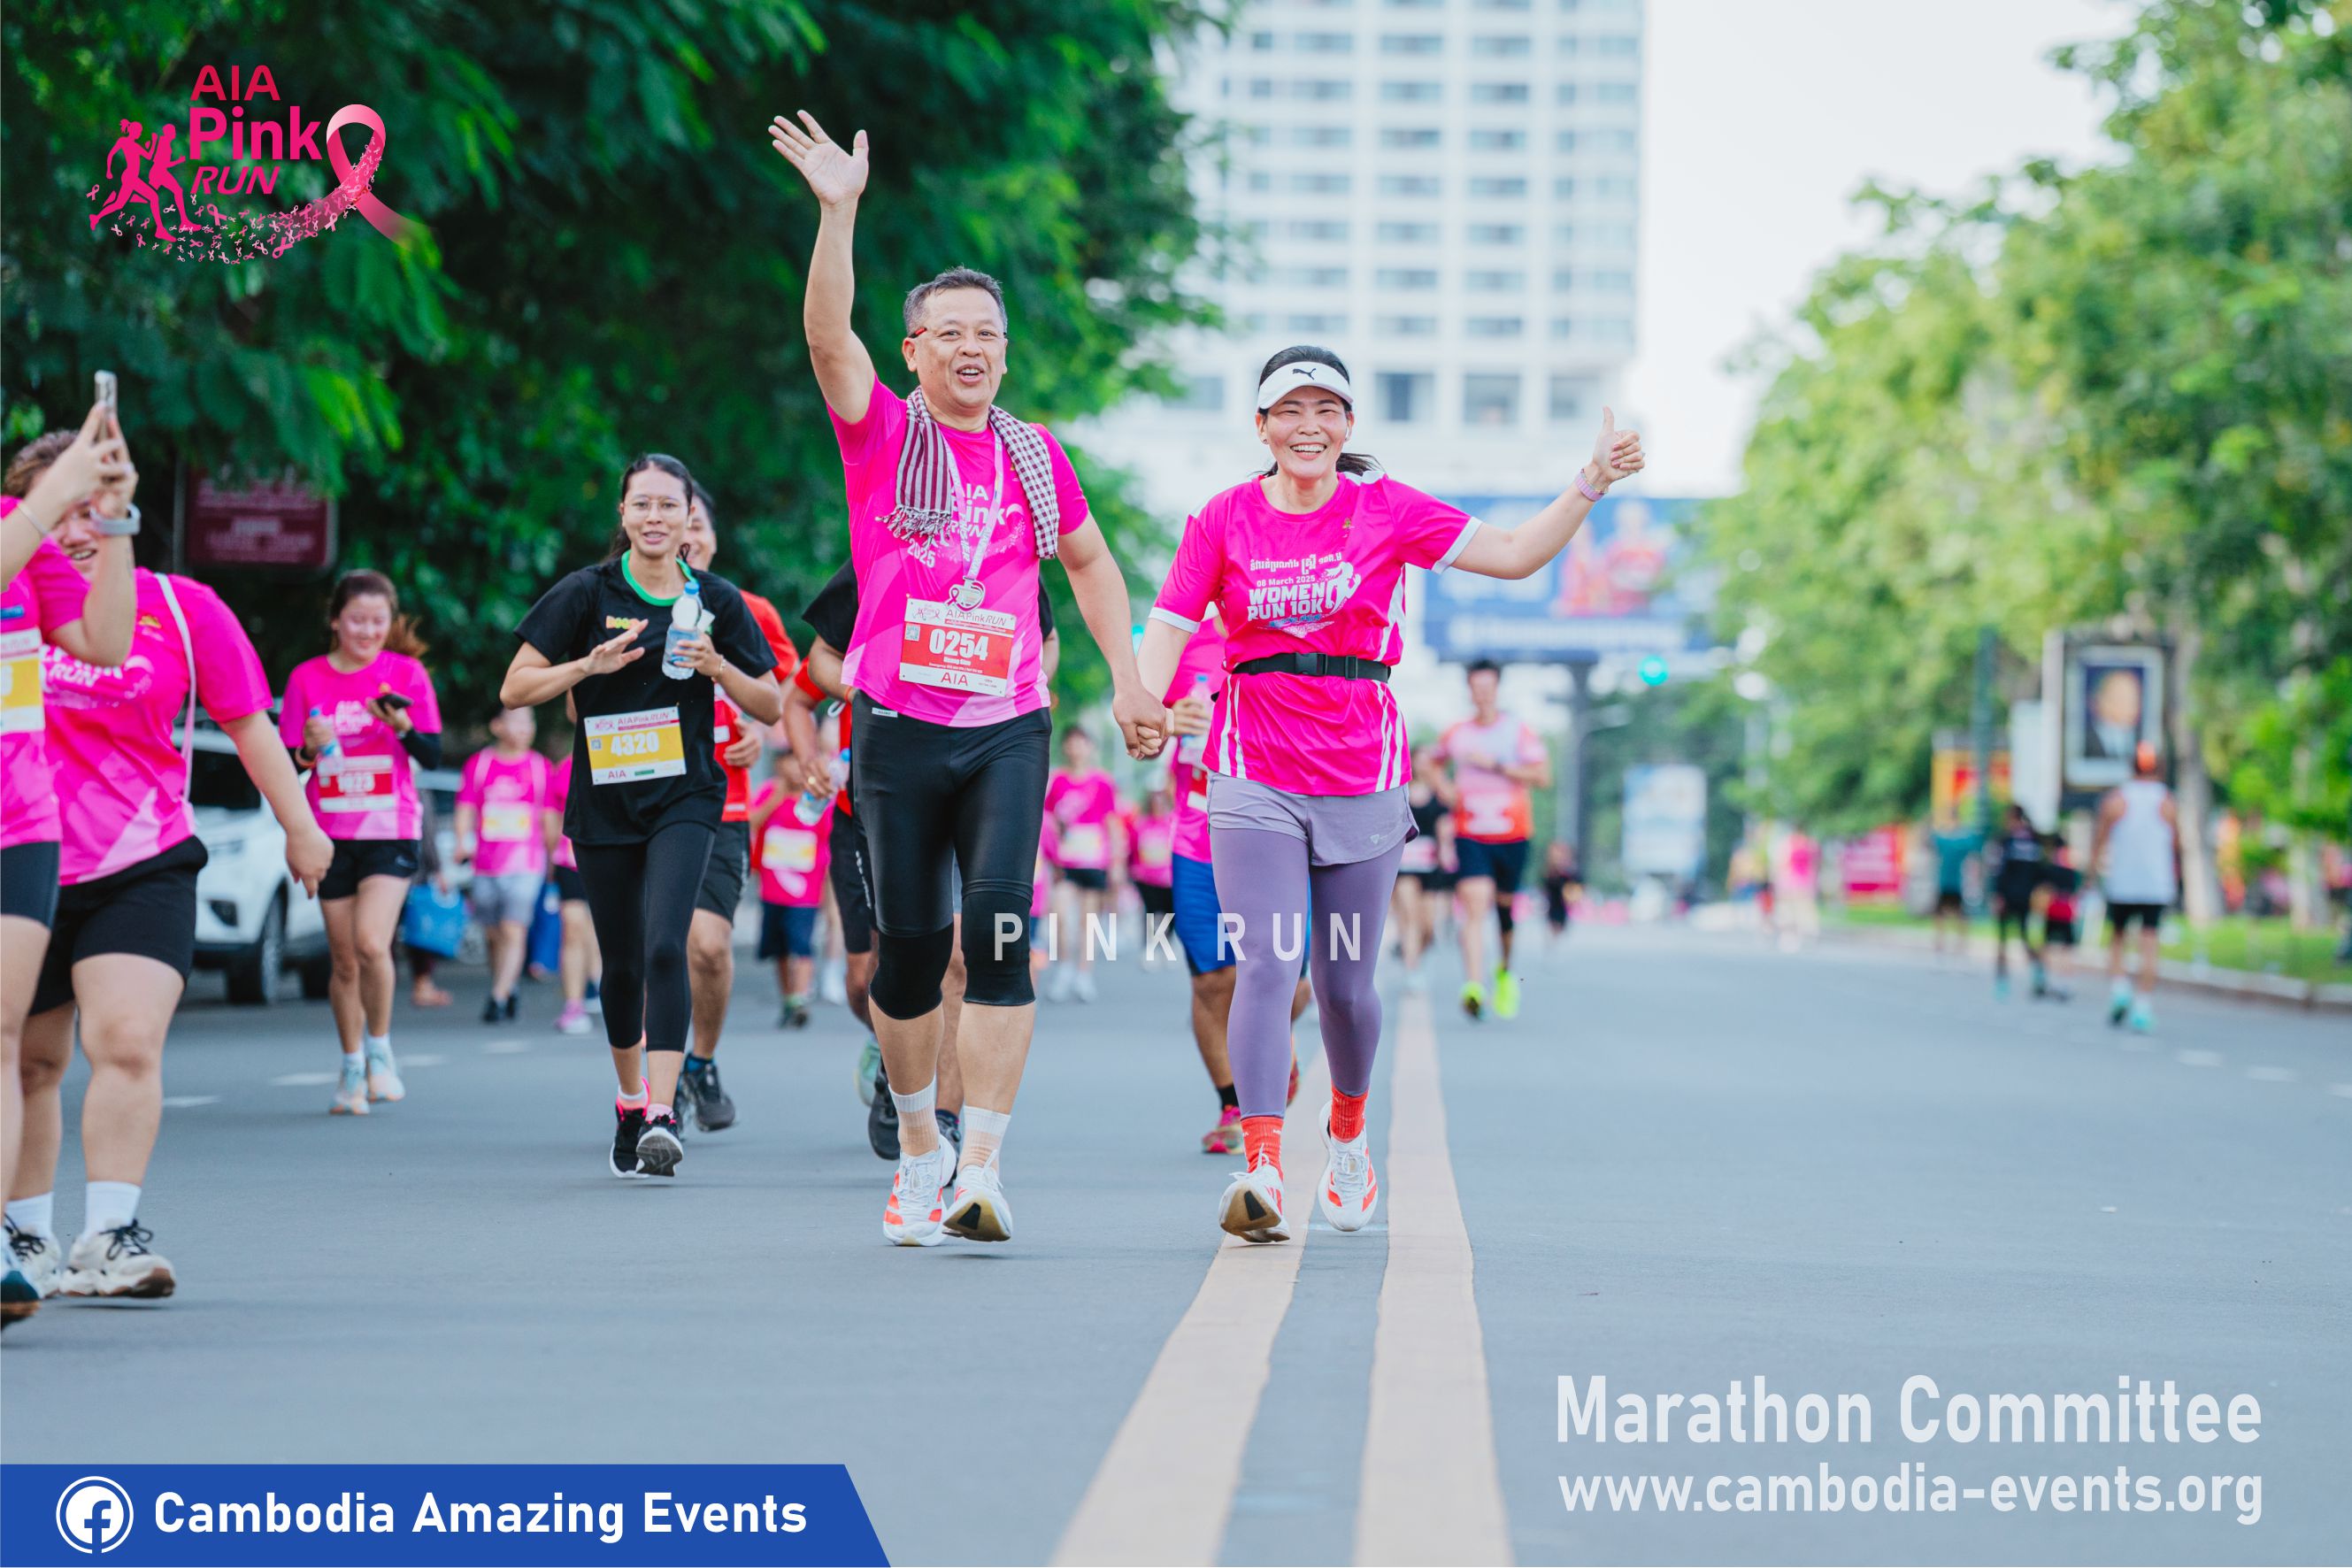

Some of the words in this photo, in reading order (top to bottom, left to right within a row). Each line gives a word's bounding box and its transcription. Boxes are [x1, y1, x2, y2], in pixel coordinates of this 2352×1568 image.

[907, 537, 936, 568] 2025
[1249, 582, 1325, 605] WOMEN
[1247, 601, 1286, 621] RUN
[1291, 598, 1323, 615] 10K
[928, 627, 989, 661] 0254
[50, 663, 100, 688] RUN
[941, 672, 969, 687] AIA
[610, 731, 660, 757] 4320
[607, 770, 626, 780] AIA
